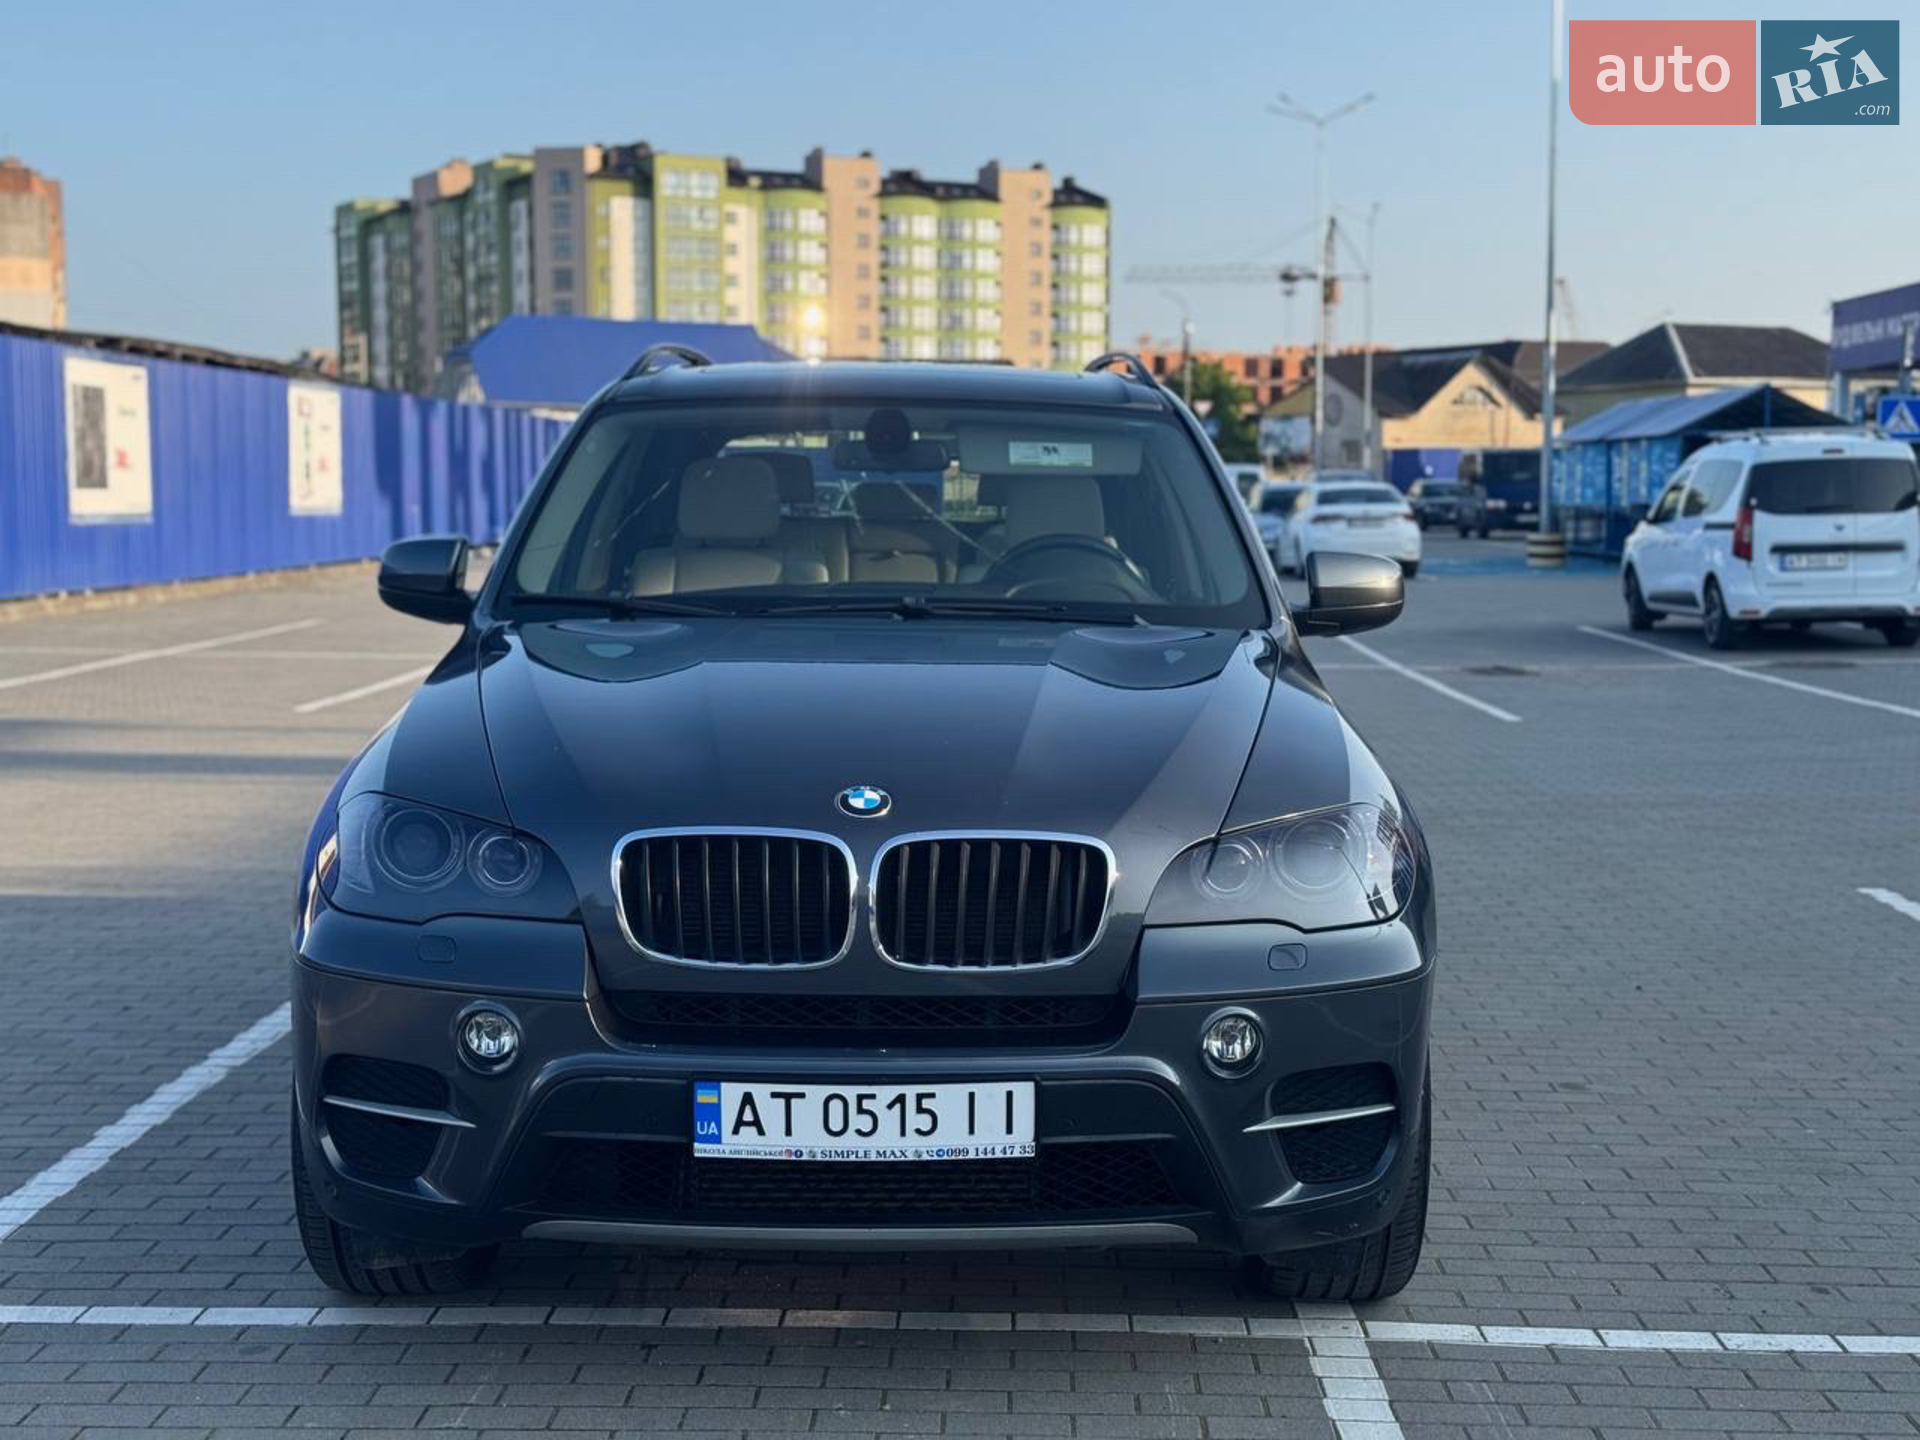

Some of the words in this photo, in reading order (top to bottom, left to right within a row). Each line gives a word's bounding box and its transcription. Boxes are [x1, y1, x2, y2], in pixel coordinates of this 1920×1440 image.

[731, 1091, 807, 1138] AT
[822, 1092, 939, 1138] 0515
[697, 1121, 719, 1136] UA
[820, 1149, 872, 1160] SIMPLE
[875, 1149, 908, 1159] MAX
[946, 1147, 970, 1158] 099
[975, 1146, 996, 1157] 144
[1000, 1145, 1016, 1156] 47
[1019, 1144, 1035, 1155] 33
